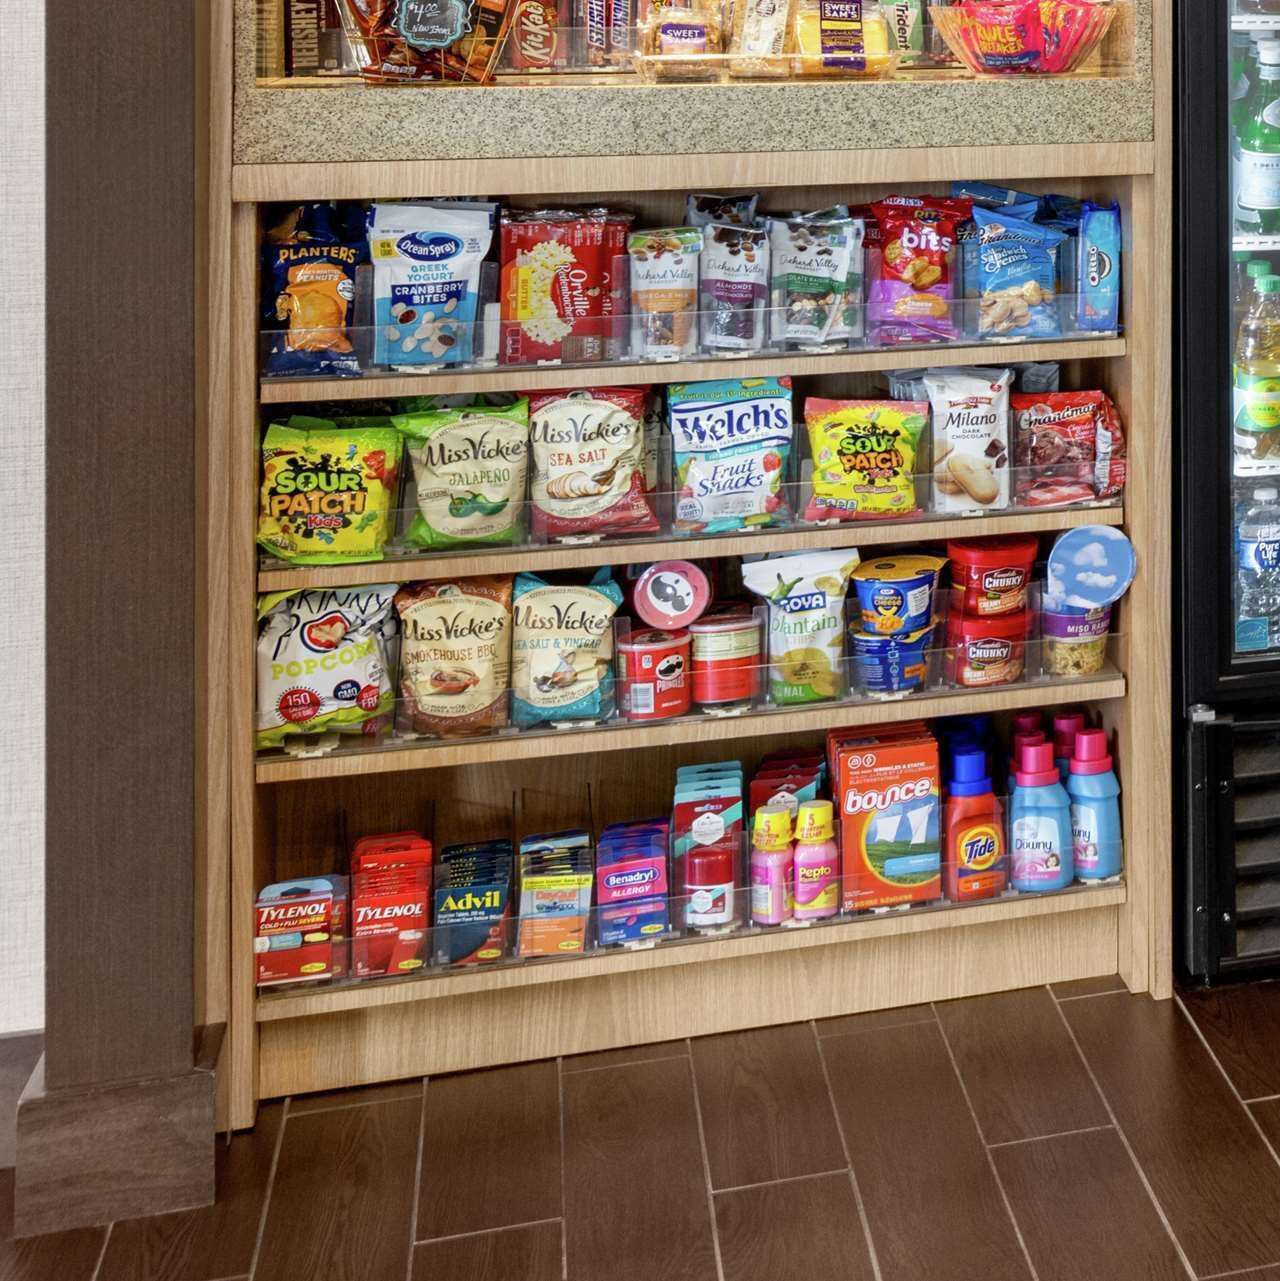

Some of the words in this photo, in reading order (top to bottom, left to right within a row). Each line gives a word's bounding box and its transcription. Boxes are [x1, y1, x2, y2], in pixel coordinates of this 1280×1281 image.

[825, 3, 857, 11] SWEET
[666, 29, 700, 39] SWEET
[896, 1, 910, 50] Trident
[914, 210, 946, 220] RITZ
[400, 240, 429, 255] Ocean
[429, 242, 456, 257] Spray
[901, 228, 952, 252] bits
[279, 247, 356, 263] PLANTERS
[410, 264, 449, 273] GREEK
[1090, 246, 1099, 287] OREO
[407, 272, 454, 282] YOGURT
[395, 282, 464, 296] CRANBERRY
[569, 270, 590, 316] Orville
[715, 282, 752, 290] ALMONDS
[412, 293, 447, 304] BITES
[529, 421, 573, 444] Miss
[568, 414, 632, 445] Vickie's
[676, 403, 789, 443] Welch's
[943, 411, 997, 431] Milano
[425, 443, 469, 467] Miss
[463, 431, 530, 459] Vickie's
[840, 436, 897, 453] SOUR
[550, 452, 573, 467] SEA
[578, 448, 608, 463] SALT
[840, 451, 904, 474] PATCH
[712, 458, 758, 481] Fruit
[275, 469, 362, 492] SOUR
[697, 473, 764, 498] Snacks
[268, 490, 367, 517] PATCH
[1259, 542, 1279, 551] Pure
[1261, 549, 1278, 559] Life
[984, 576, 1023, 588] CHUNKY
[401, 619, 443, 642] Miss
[439, 610, 506, 642] Vickie's
[513, 606, 555, 630] Miss
[552, 602, 613, 635] Vickie's
[529, 638, 550, 649] SALT
[553, 638, 561, 648] &
[563, 637, 602, 648] VINEGAR
[404, 647, 473, 665] SMOKEHOUSE
[477, 643, 499, 659] BBQ
[969, 646, 1009, 658] CHUNKY
[656, 676, 685, 693] PRINGLES
[287, 692, 310, 706] 150
[338, 688, 357, 699] GMO
[845, 778, 932, 814] bounce
[808, 815, 815, 826] 5
[965, 837, 995, 864] Tide
[1016, 838, 1053, 851] Downy
[608, 870, 654, 886] Benadryl
[799, 866, 831, 876] Pepto
[611, 885, 651, 898] ALLERGY
[439, 891, 500, 912] Advil
[259, 903, 327, 923] TYLENOL
[355, 903, 423, 922] TYLENOL
